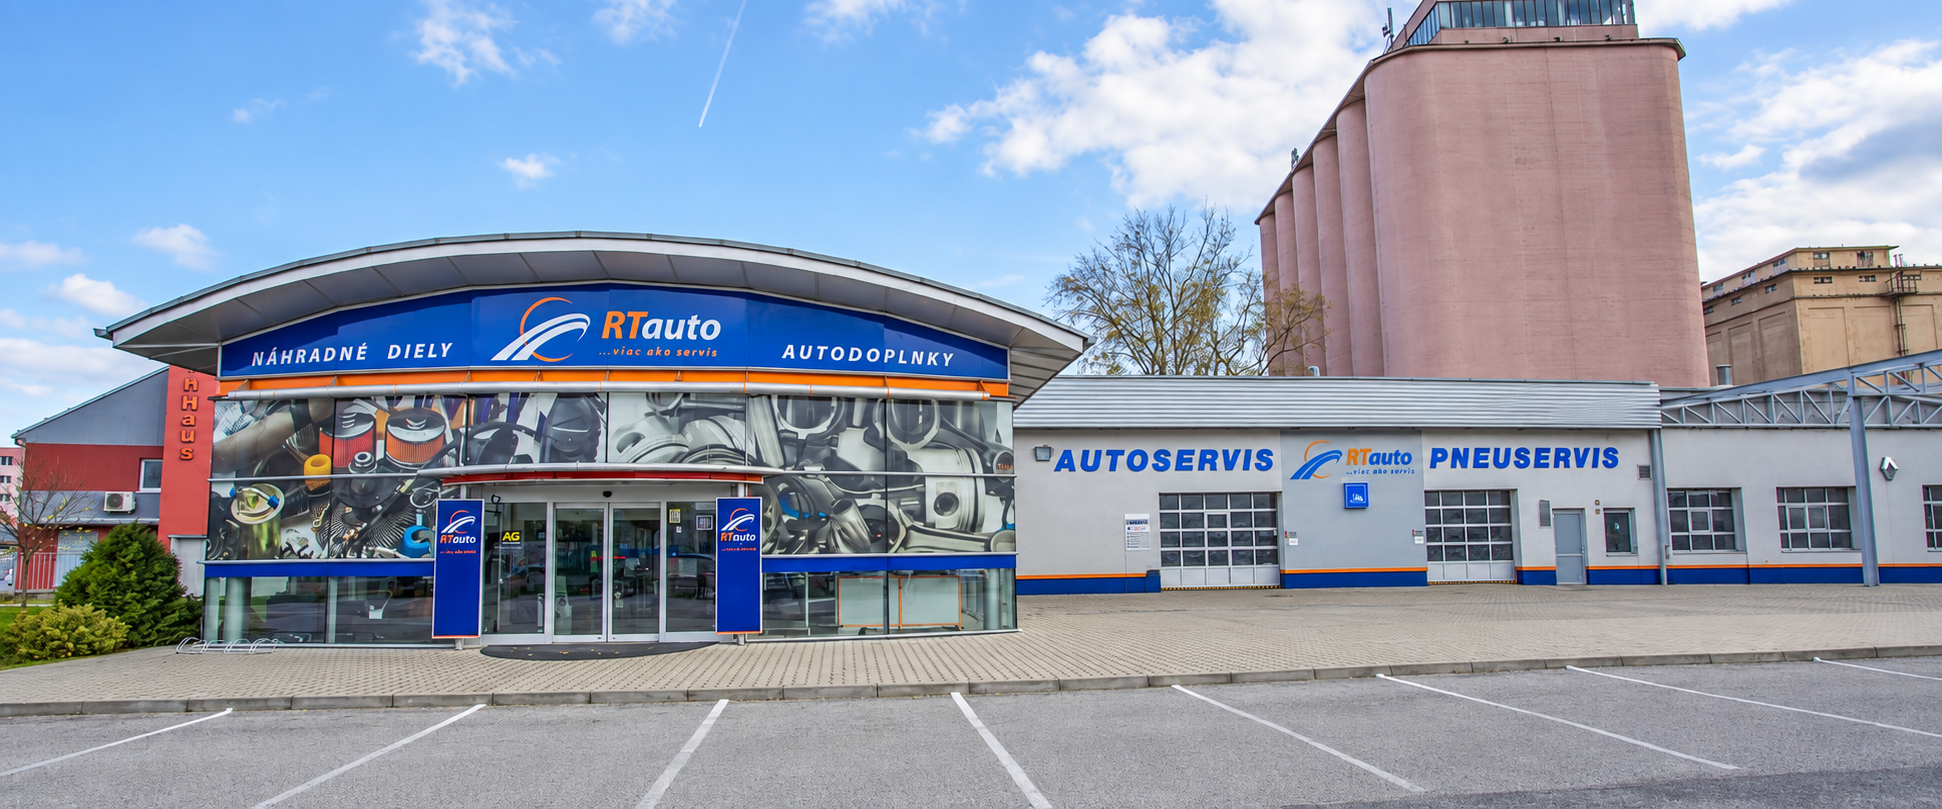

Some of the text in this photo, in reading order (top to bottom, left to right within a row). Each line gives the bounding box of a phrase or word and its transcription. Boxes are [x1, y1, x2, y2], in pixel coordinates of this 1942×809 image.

[601, 310, 722, 341] RTauto
[251, 342, 453, 367] NÁHRADNÉ DIELY
[598, 346, 718, 357] ...viac ako servis
[781, 344, 954, 367] AUTODOPLNKY
[1053, 448, 1275, 473] AUTOSERVIS
[1346, 448, 1413, 466] RTauto
[1429, 446, 1620, 470] PNEUSERVIS
[502, 531, 520, 542] AG
[720, 532, 757, 542] RTauto
